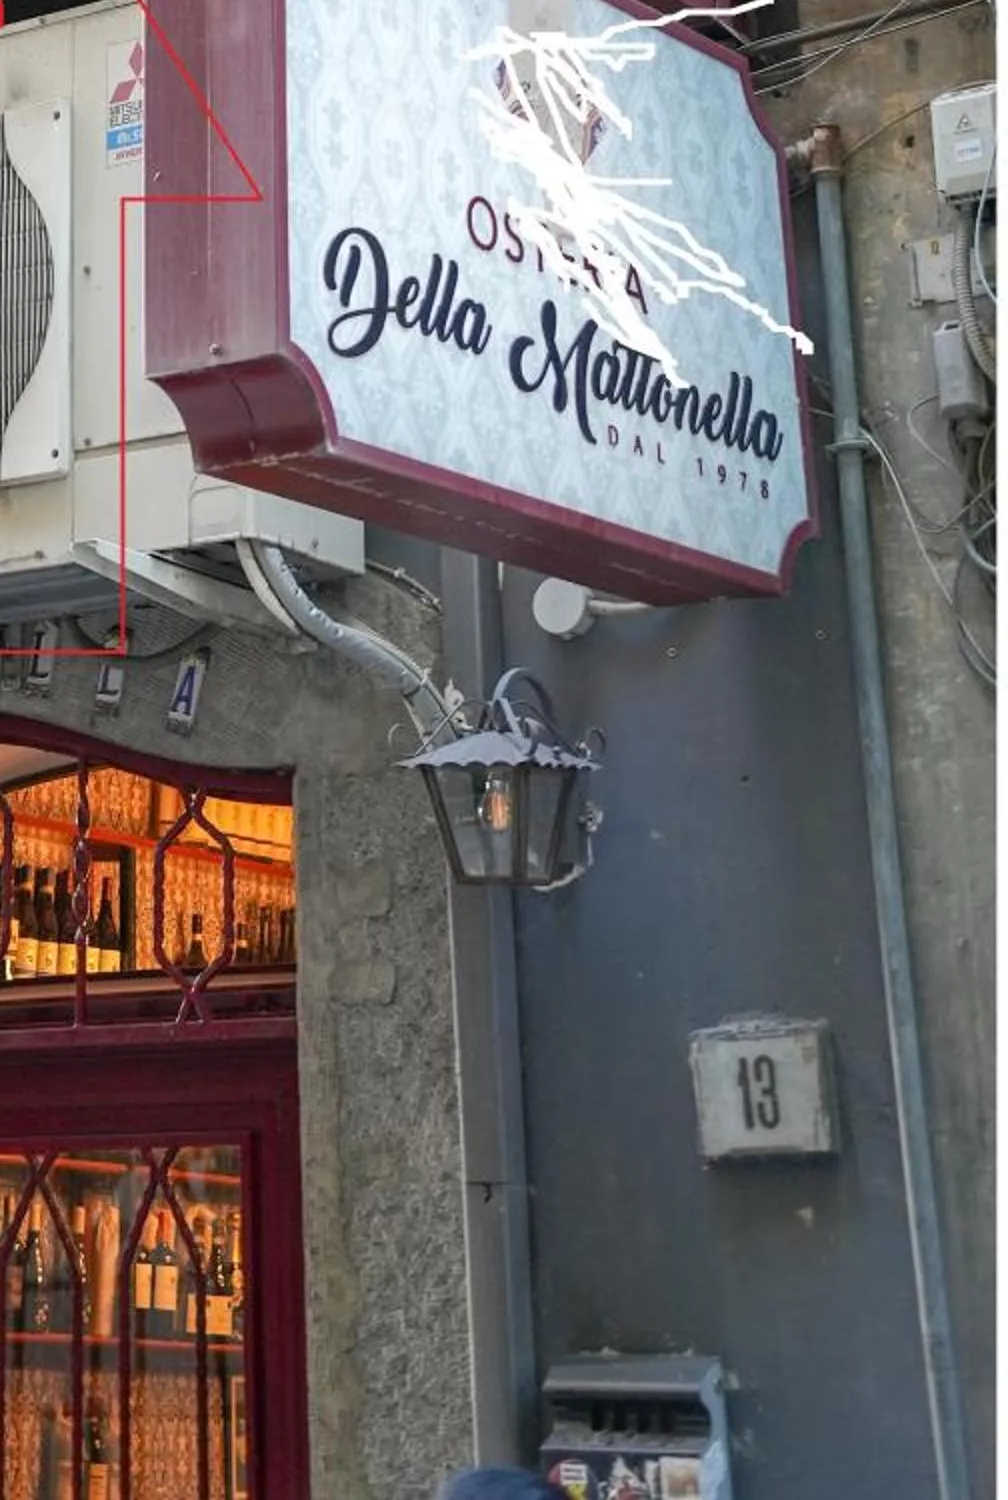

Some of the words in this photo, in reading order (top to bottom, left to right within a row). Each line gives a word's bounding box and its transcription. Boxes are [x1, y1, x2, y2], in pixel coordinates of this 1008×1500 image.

[323, 227, 493, 358] Della
[509, 299, 783, 461] Mattonella
[607, 424, 665, 465] DAL
[696, 457, 769, 499] 1978
[737, 1054, 780, 1131] 13
